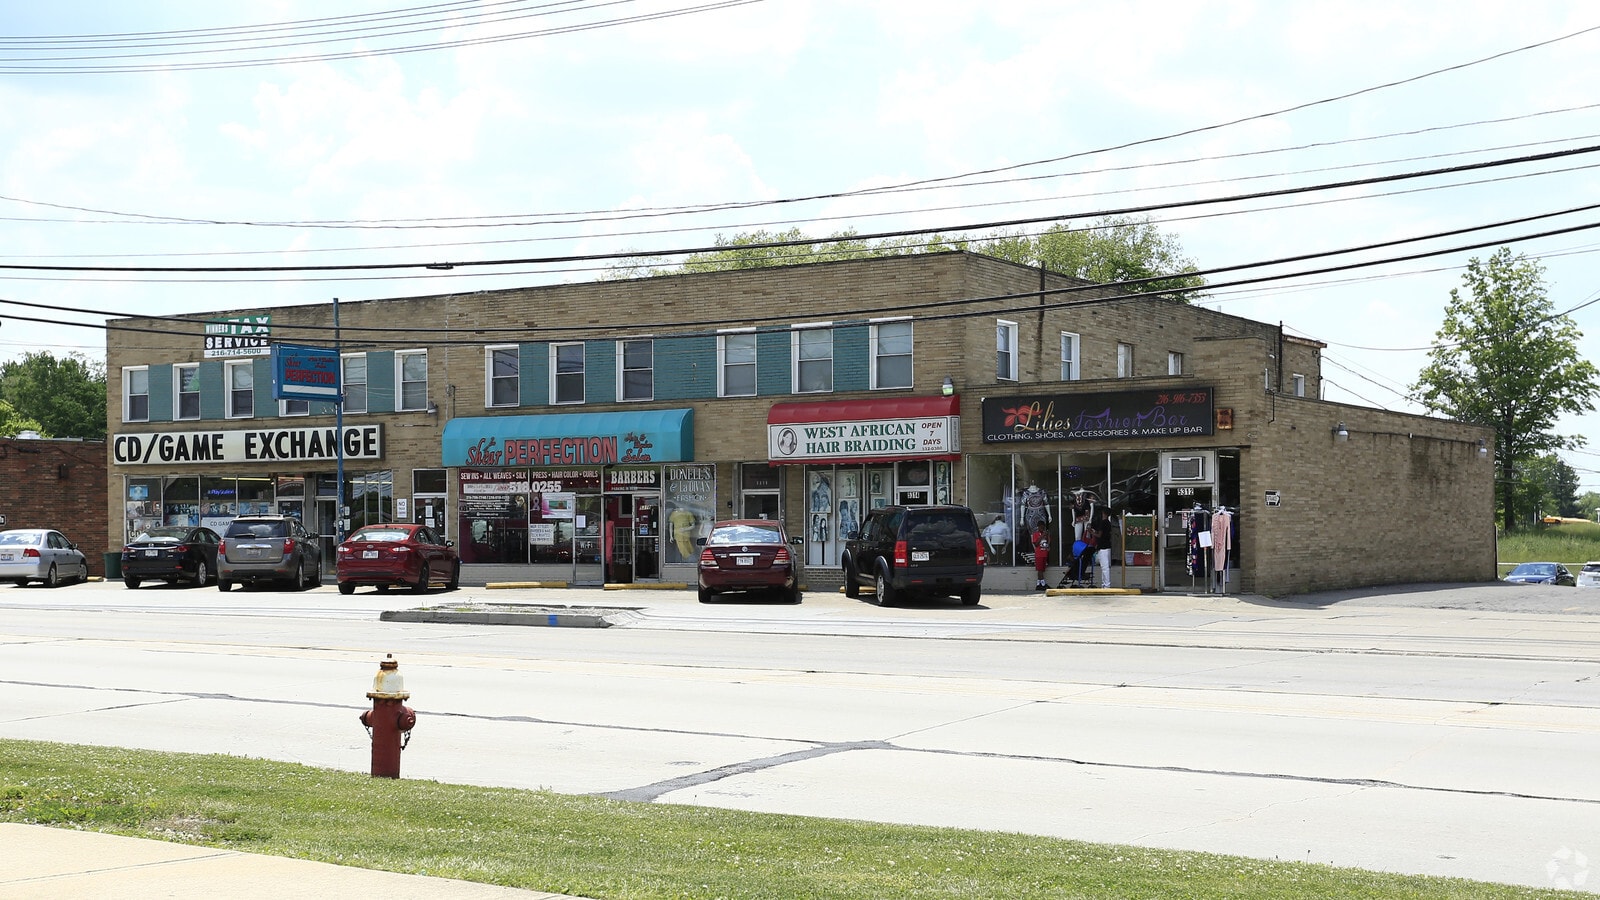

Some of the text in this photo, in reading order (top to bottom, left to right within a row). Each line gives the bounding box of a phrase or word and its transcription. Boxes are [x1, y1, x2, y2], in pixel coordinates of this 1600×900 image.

[228, 316, 269, 334] TAX
[206, 334, 268, 349] SERVICE
[212, 348, 261, 356] 216-714-5600
[285, 368, 336, 384] PERFECTION
[1014, 401, 1071, 432] Lilies
[1148, 406, 1188, 427] Bar
[804, 422, 916, 439] WEST AFRICAN
[987, 433, 1033, 441] CLOTHING,
[1034, 430, 1066, 440] SHOES,
[1068, 428, 1129, 438] ACCESSORIES
[114, 428, 376, 464] CD/GAME EXCHANGE
[466, 436, 618, 466] Shear PERFECTION
[806, 438, 916, 454] HAIR BRAIDING
[621, 448, 652, 462] Salon
[492, 472, 512, 480] WEAVES
[611, 470, 656, 484] BARBERS
[510, 481, 562, 492] 518.0255
[1126, 526, 1150, 536] SALE
